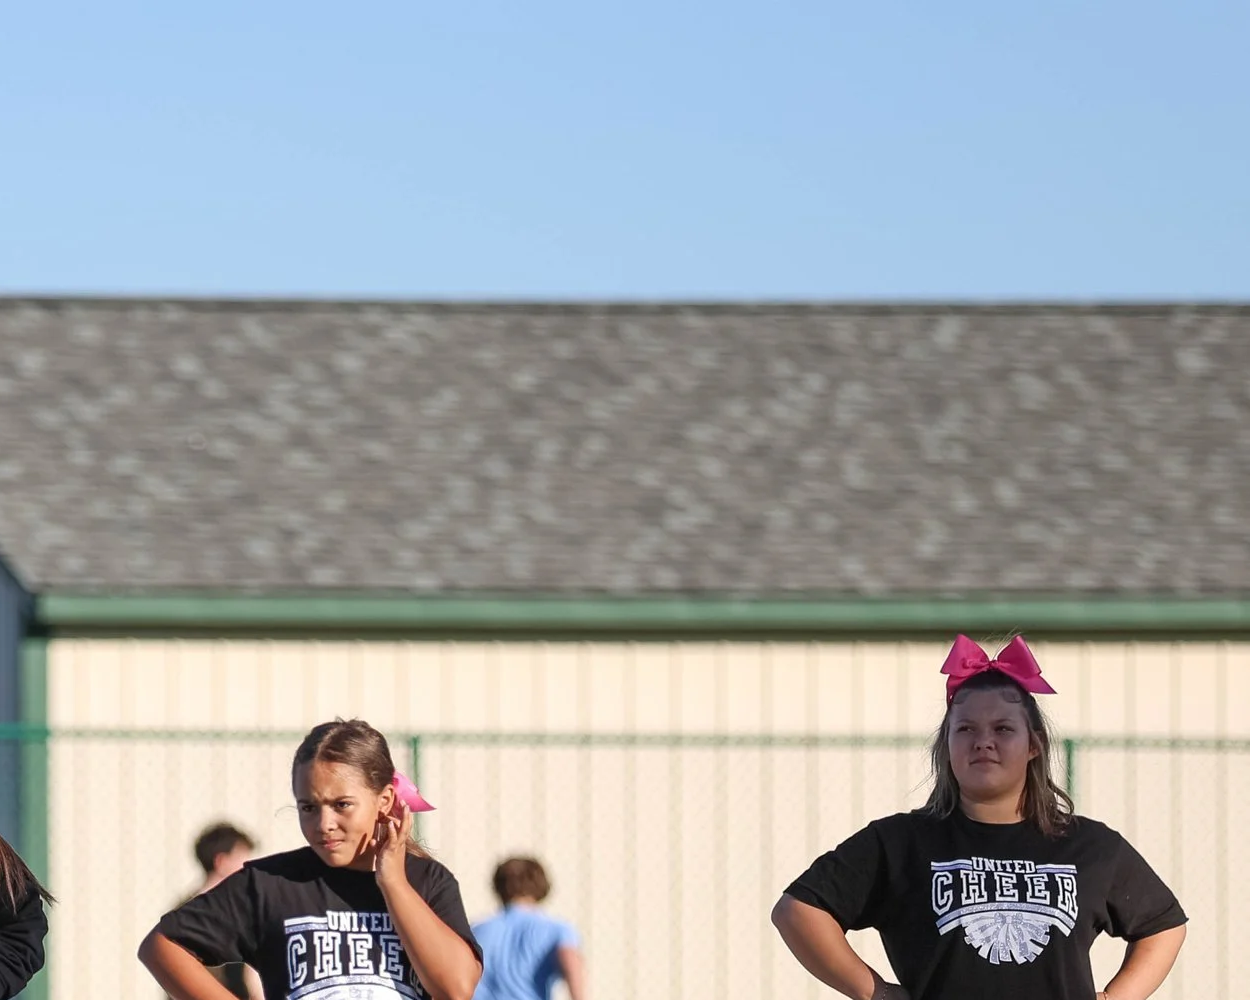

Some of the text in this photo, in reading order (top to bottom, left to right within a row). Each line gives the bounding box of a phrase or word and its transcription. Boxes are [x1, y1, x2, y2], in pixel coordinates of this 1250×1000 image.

[971, 856, 1037, 874] UNITED
[931, 870, 1079, 921] CHEER
[326, 910, 394, 933] UNITED
